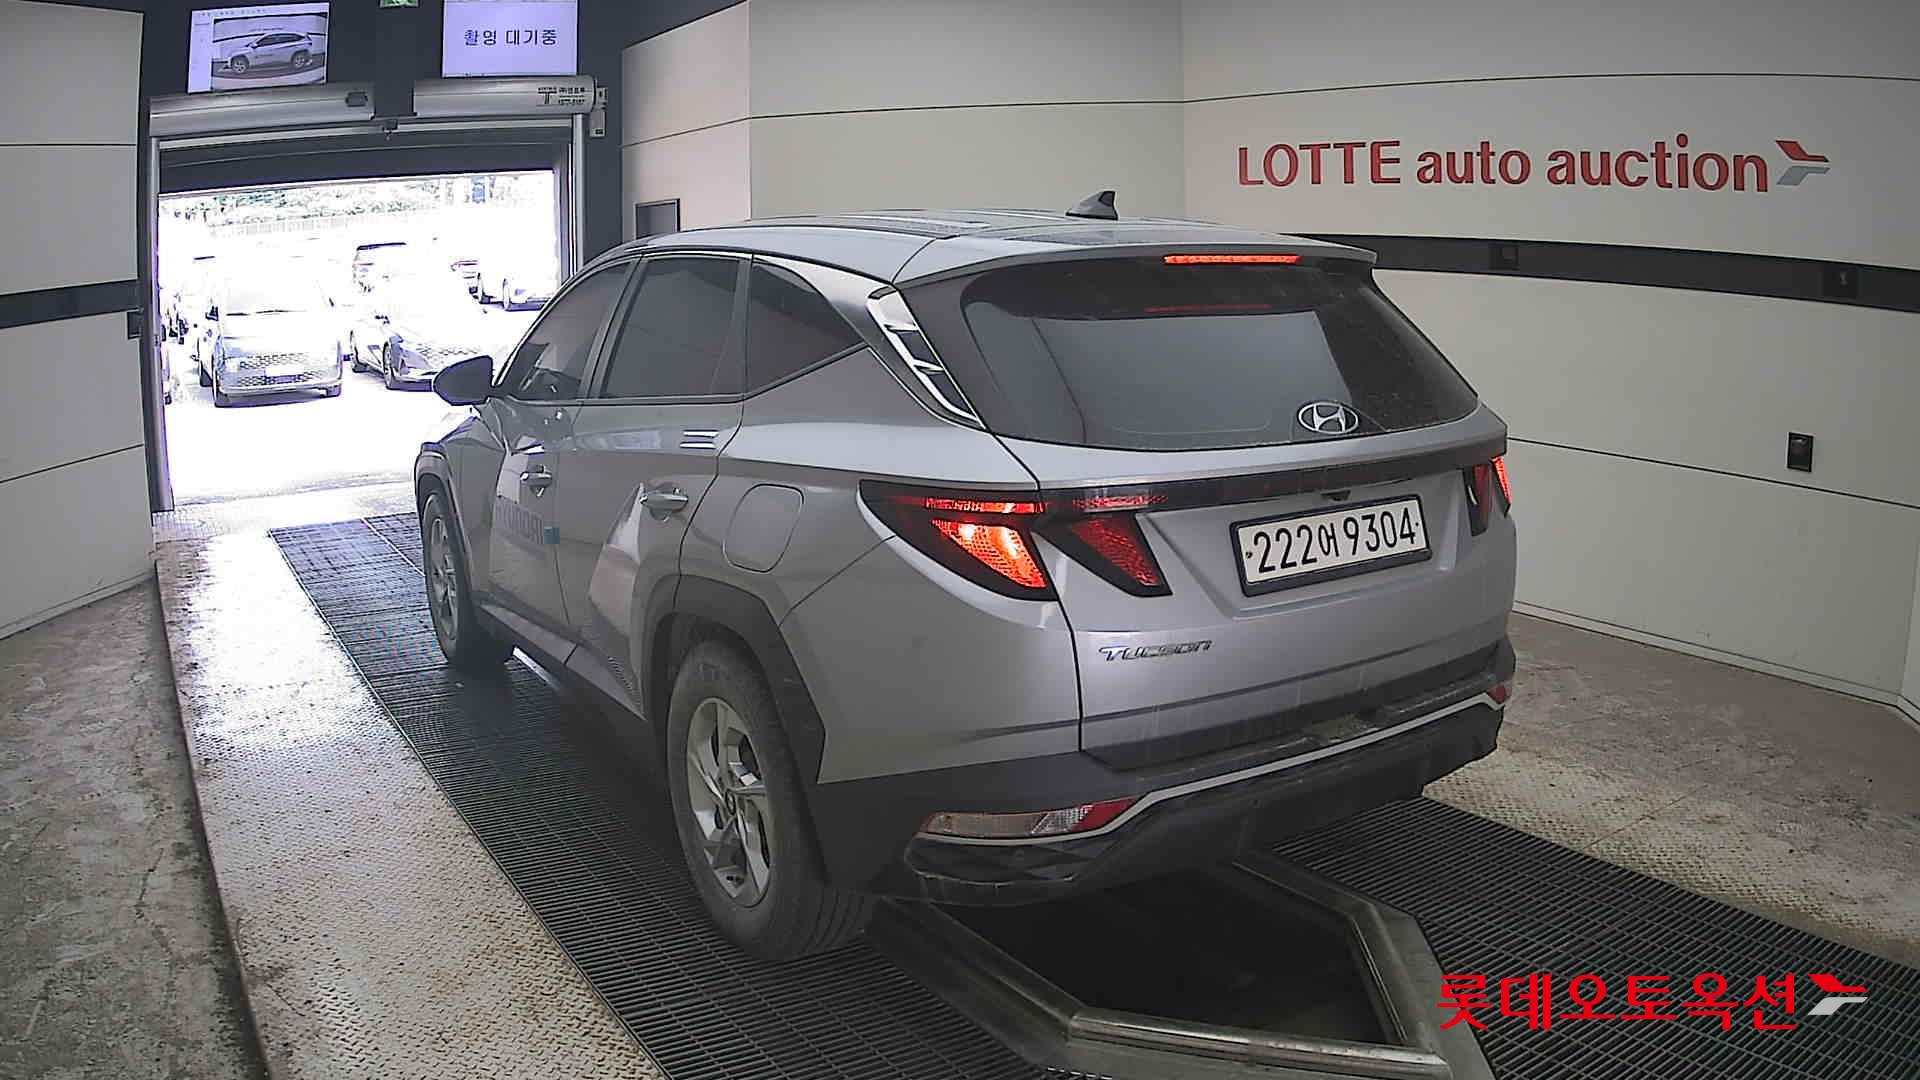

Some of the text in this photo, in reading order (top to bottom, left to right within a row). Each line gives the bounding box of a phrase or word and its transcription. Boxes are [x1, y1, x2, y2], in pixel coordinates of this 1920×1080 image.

[505, 29, 557, 46] 대기중
[1237, 133, 1769, 193] LOTTE auto auction
[1343, 507, 1416, 556] 9304
